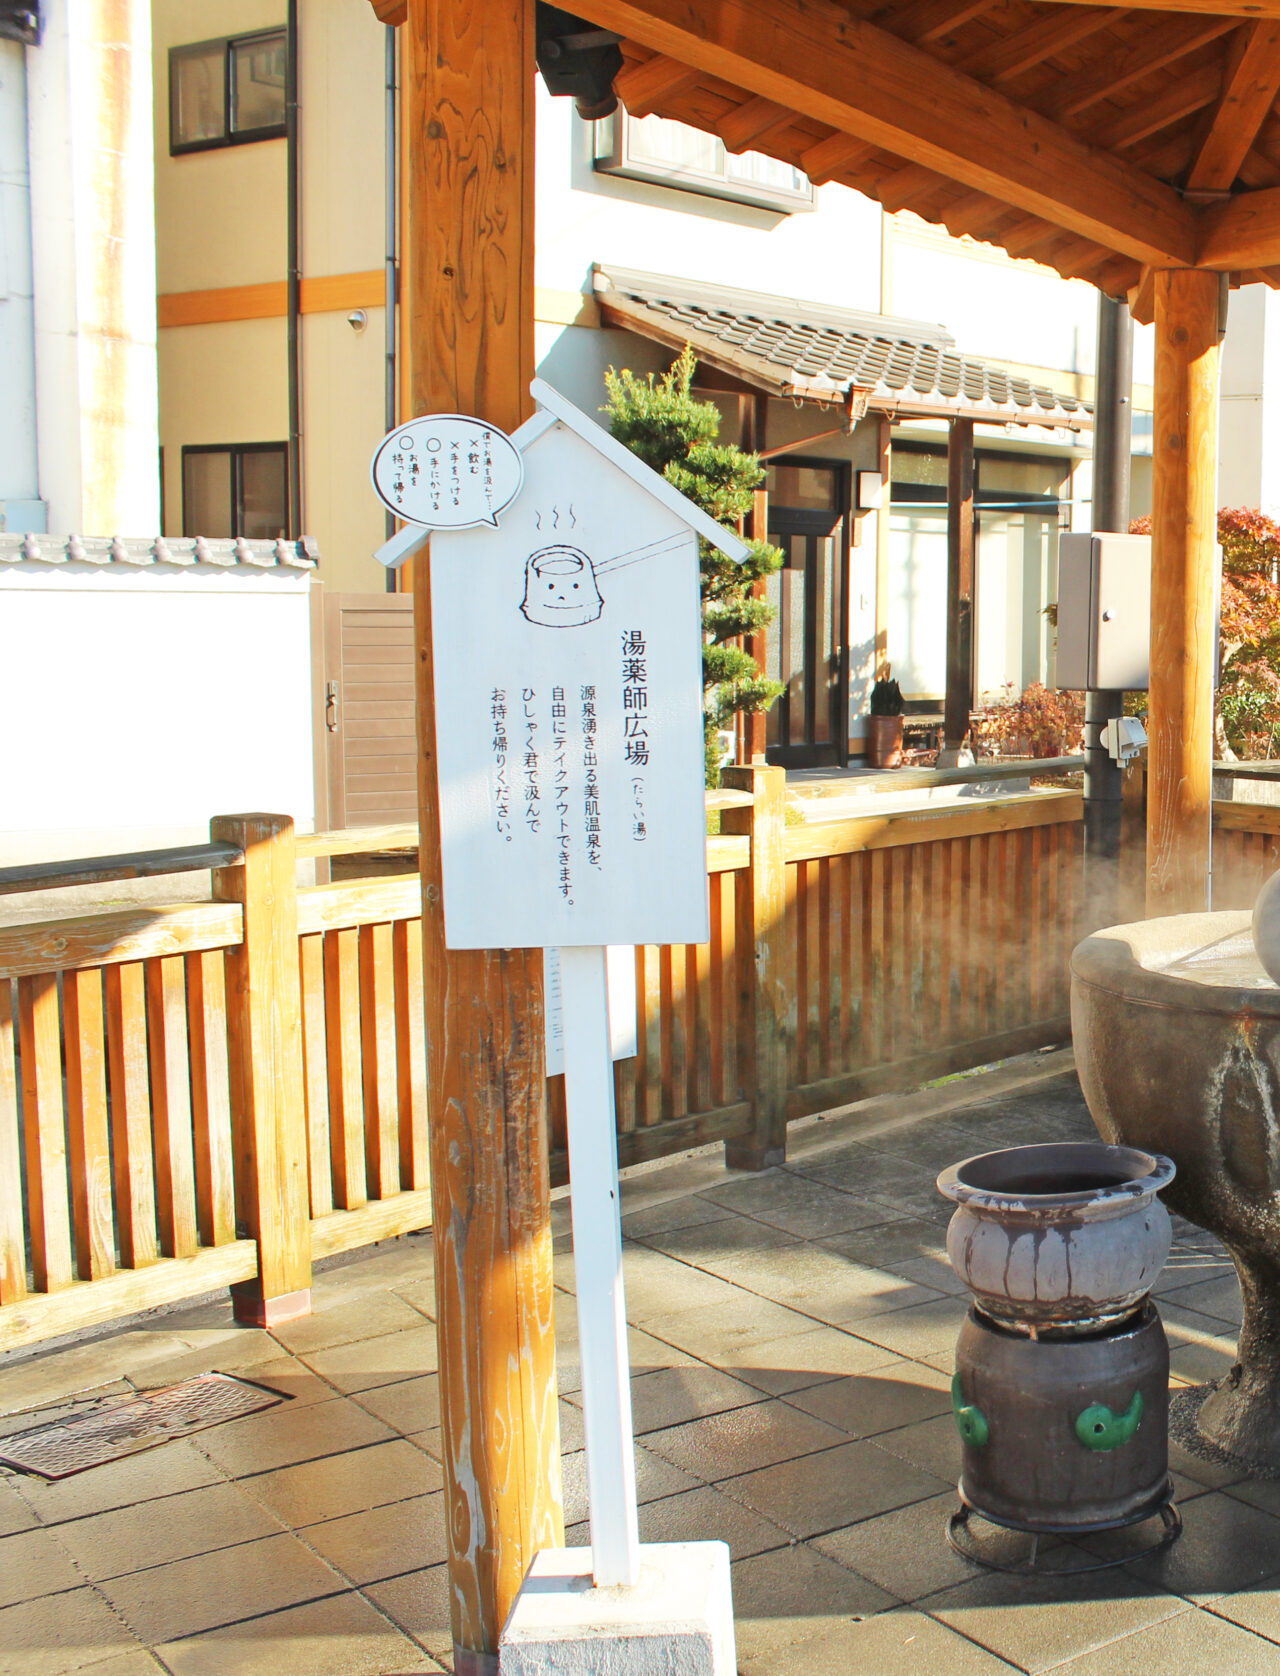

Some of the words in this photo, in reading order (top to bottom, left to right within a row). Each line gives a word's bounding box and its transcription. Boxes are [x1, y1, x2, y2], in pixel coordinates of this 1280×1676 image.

[491, 688, 512, 841] お持ち帰りください。
[521, 688, 540, 832] ひしゃく君で汲んで
[621, 630, 650, 766] 湯薬師広場
[552, 686, 574, 905] 自由にテイクアウトできます。
[580, 685, 602, 871] 源泉湧き出る美肌温泉を、
